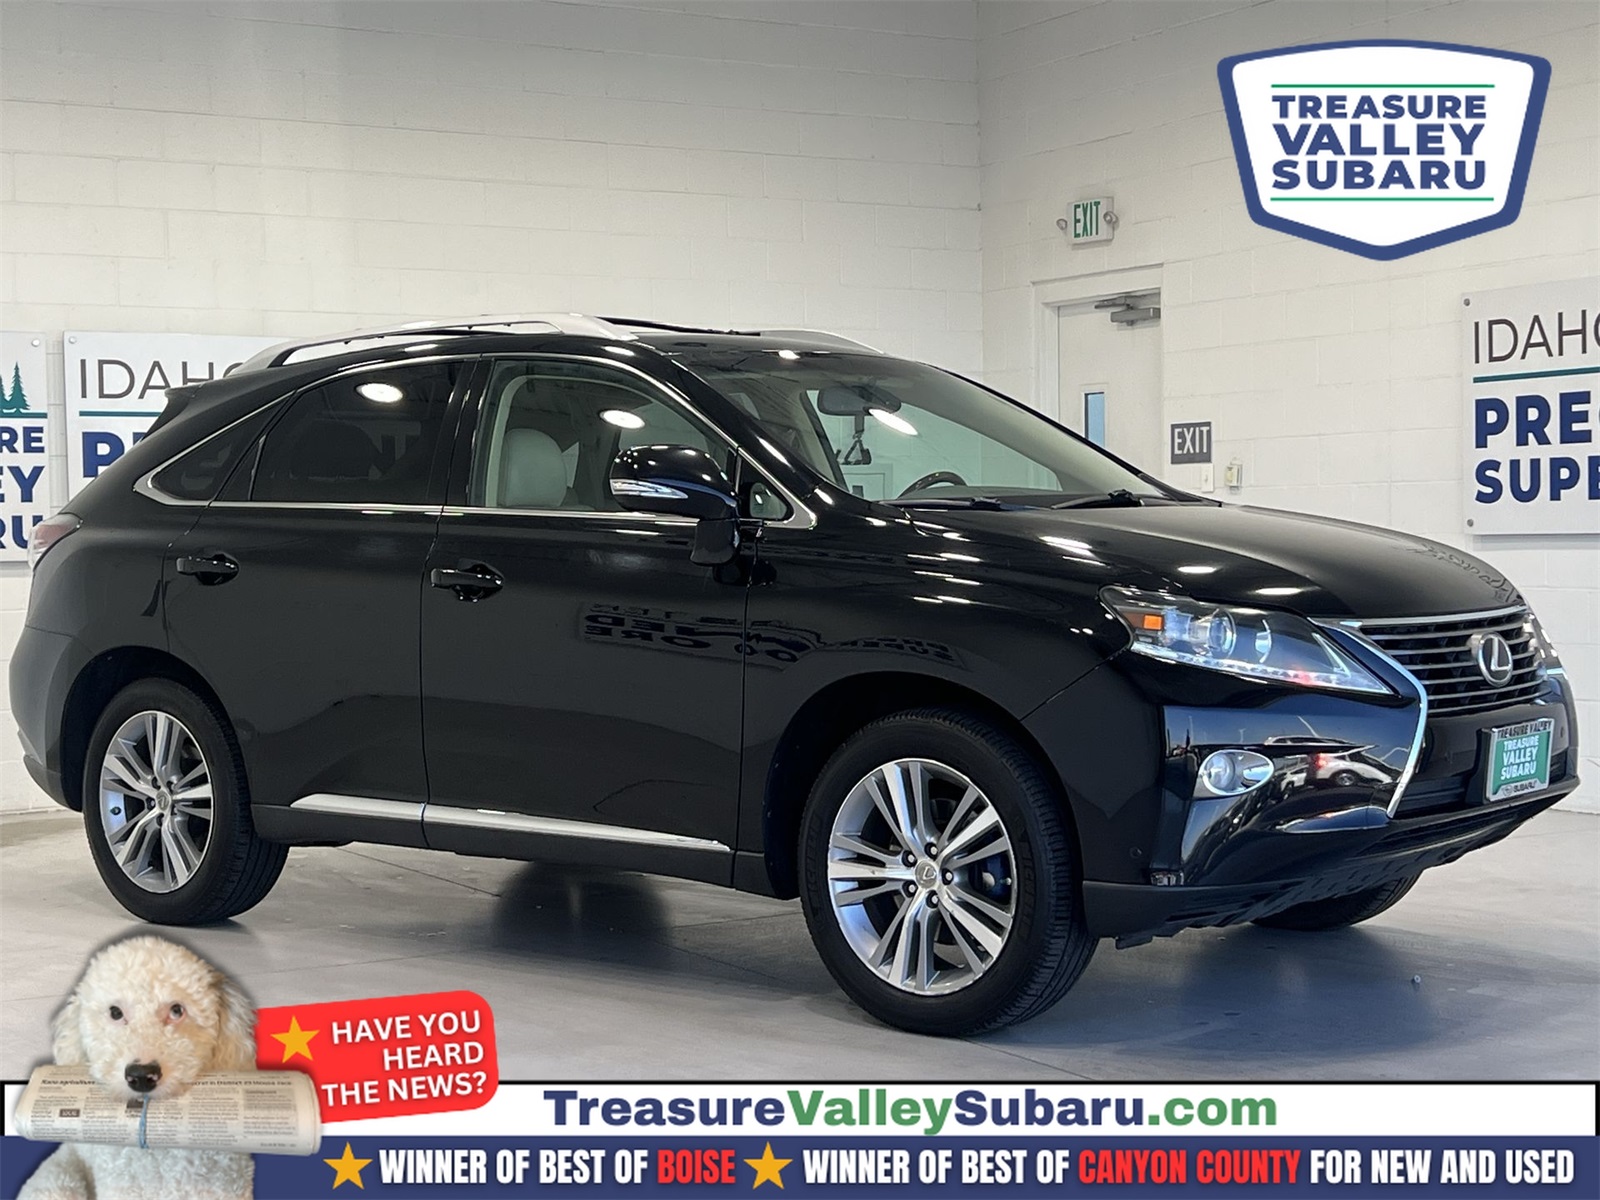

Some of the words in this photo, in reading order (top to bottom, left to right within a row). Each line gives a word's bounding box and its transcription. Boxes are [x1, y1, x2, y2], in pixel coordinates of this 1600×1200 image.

[1073, 200, 1101, 239] EXIT
[1473, 309, 1600, 364] IDAH
[80, 358, 244, 400] IDAH
[1475, 390, 1600, 449] PRE
[1173, 426, 1210, 455] EXIT
[0, 466, 45, 503] Y
[1497, 724, 1528, 739] TREASURE
[1529, 720, 1552, 733] VALLEY
[1503, 735, 1539, 751] TREASURE
[1500, 761, 1536, 780] SUBARU
[1502, 746, 1538, 766] VALLEY
[1513, 780, 1537, 793] SUBARU
